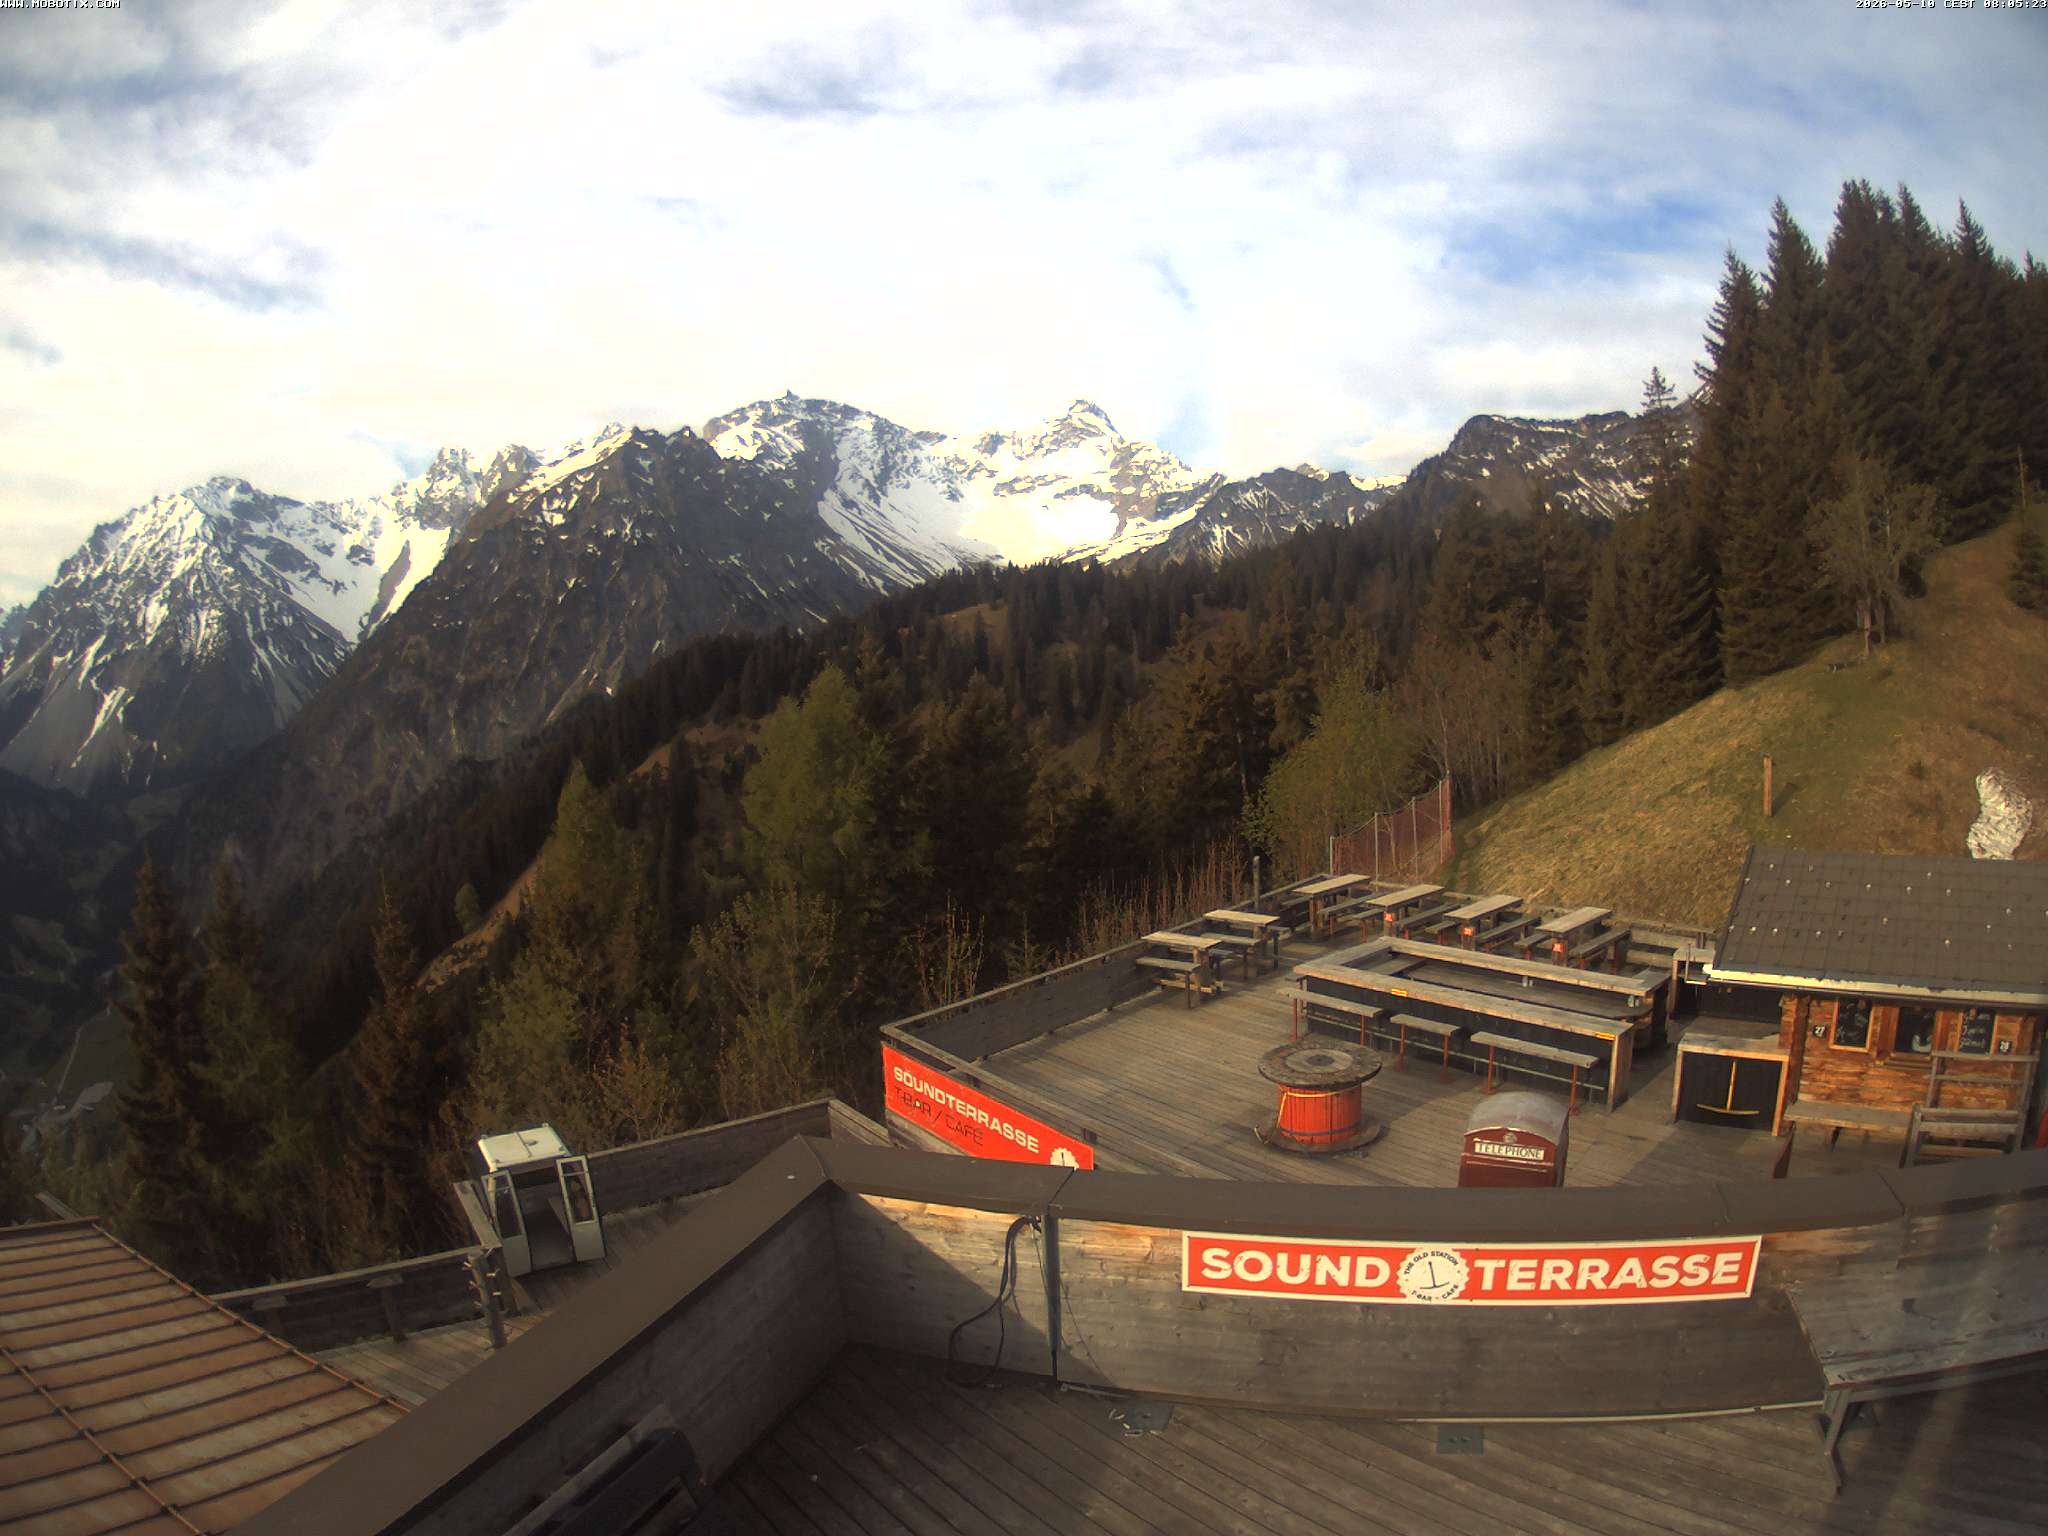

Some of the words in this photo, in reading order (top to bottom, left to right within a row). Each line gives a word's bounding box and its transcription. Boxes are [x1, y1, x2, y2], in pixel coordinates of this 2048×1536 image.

[893, 1065, 1040, 1154] SOUNDTERRASSE
[1477, 1143, 1544, 1160] TELEPHONE
[1200, 1246, 1391, 1288] SOUND
[1474, 1252, 1743, 1291] TERRASSE
[1404, 1262, 1415, 1275] THE
[1413, 1252, 1429, 1263] OLD
